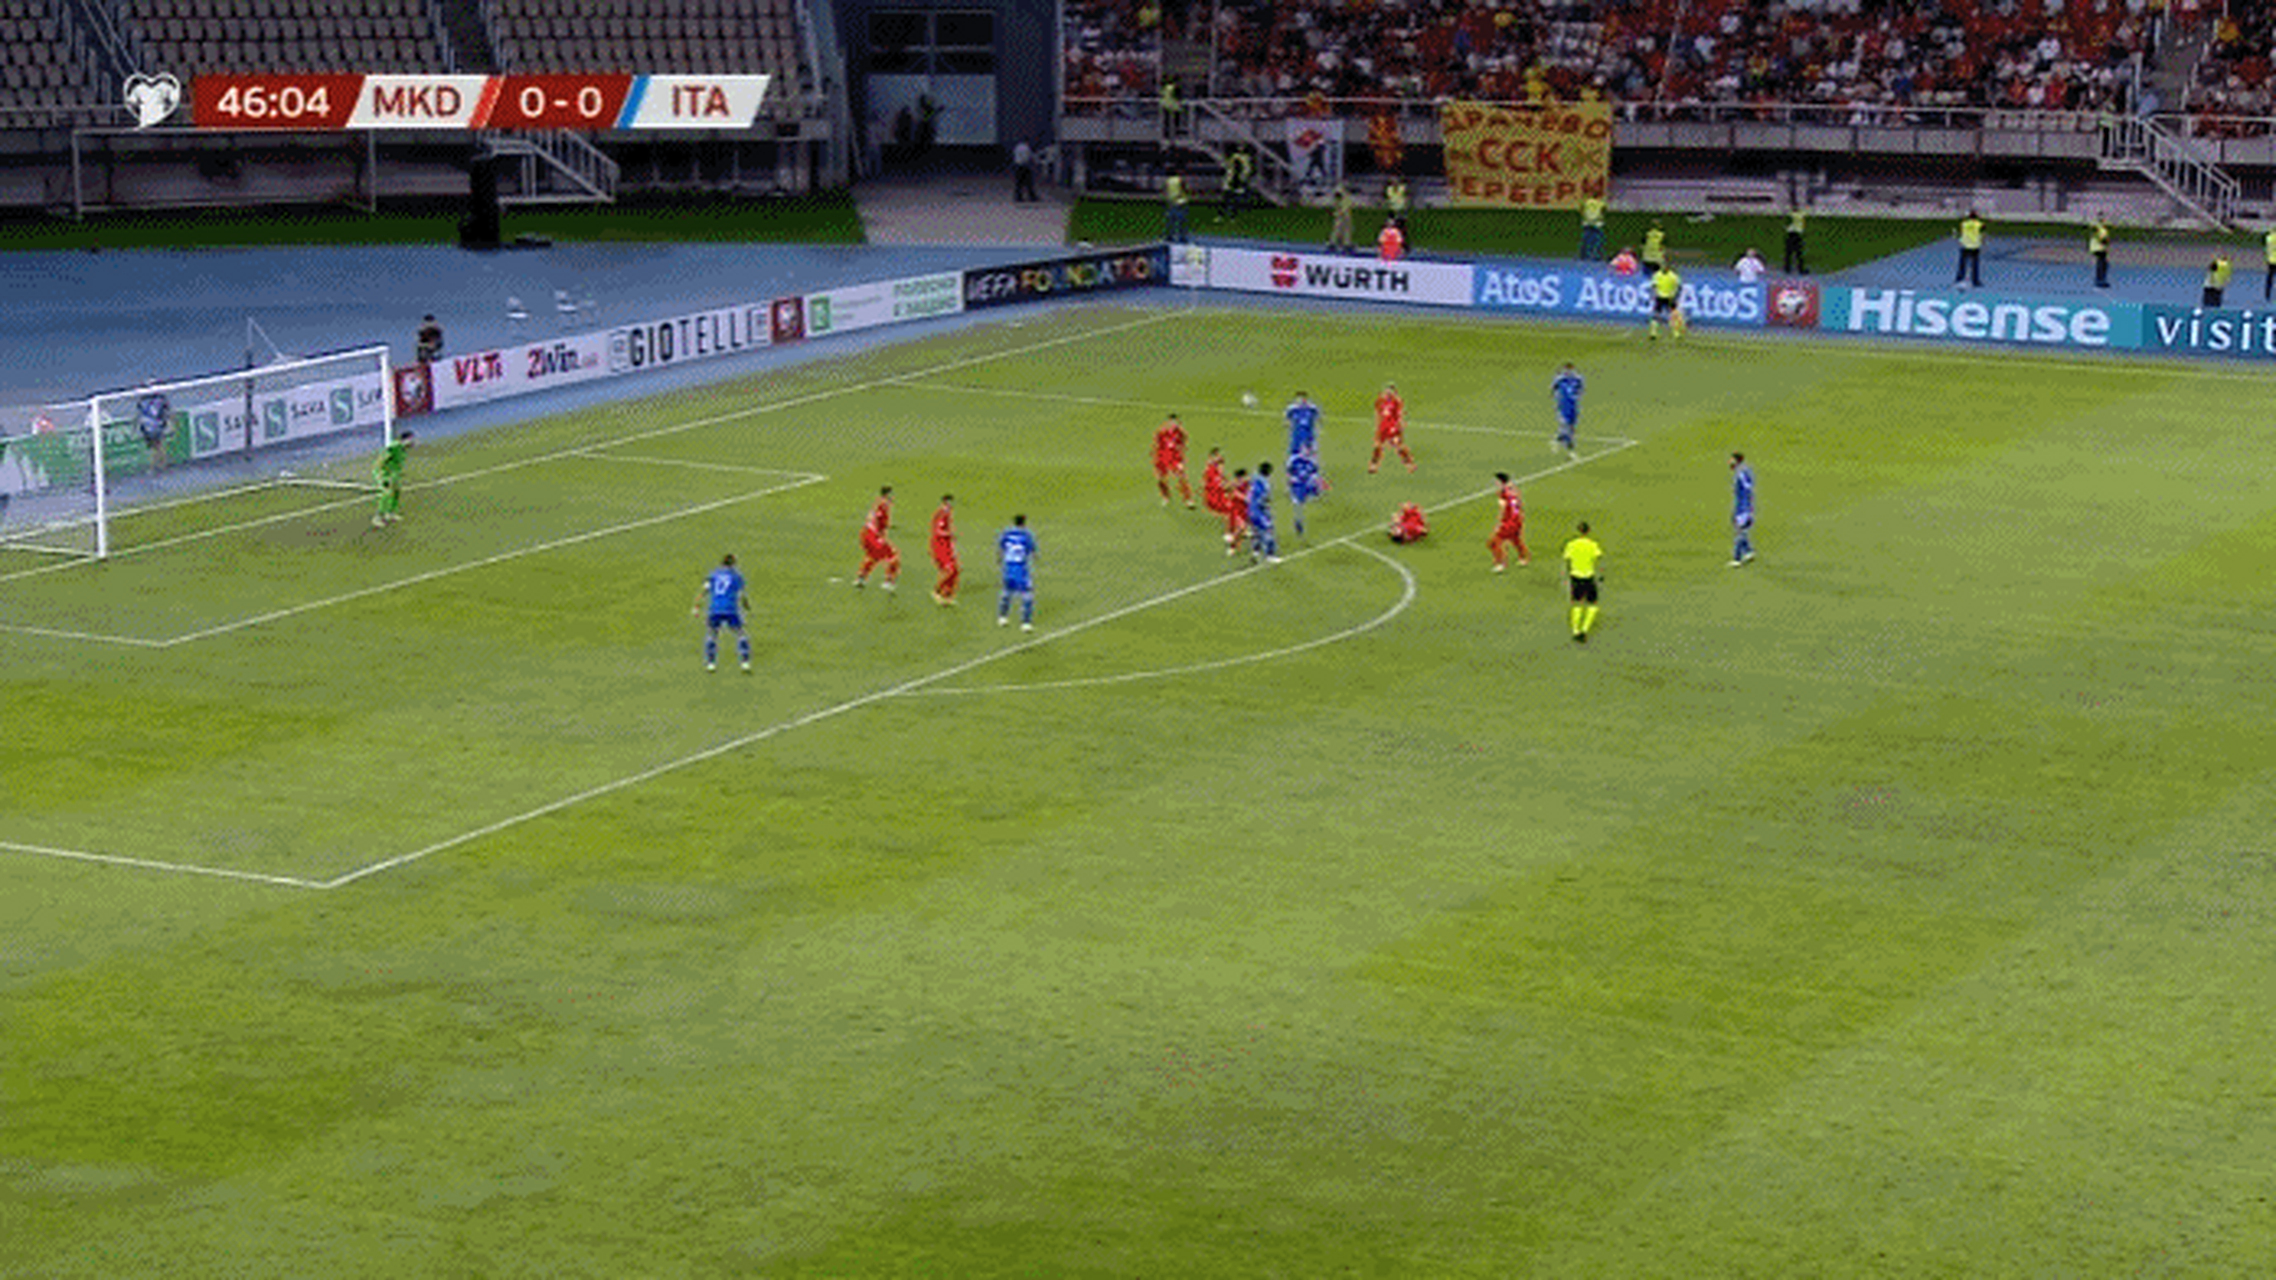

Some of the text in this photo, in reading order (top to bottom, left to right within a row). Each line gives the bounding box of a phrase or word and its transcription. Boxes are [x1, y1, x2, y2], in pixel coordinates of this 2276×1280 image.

[1305, 264, 1410, 292] WÜRTH
[629, 310, 753, 367] GIOTELLI
[1847, 287, 2111, 345] Hisense
[2156, 308, 2276, 352] visit
